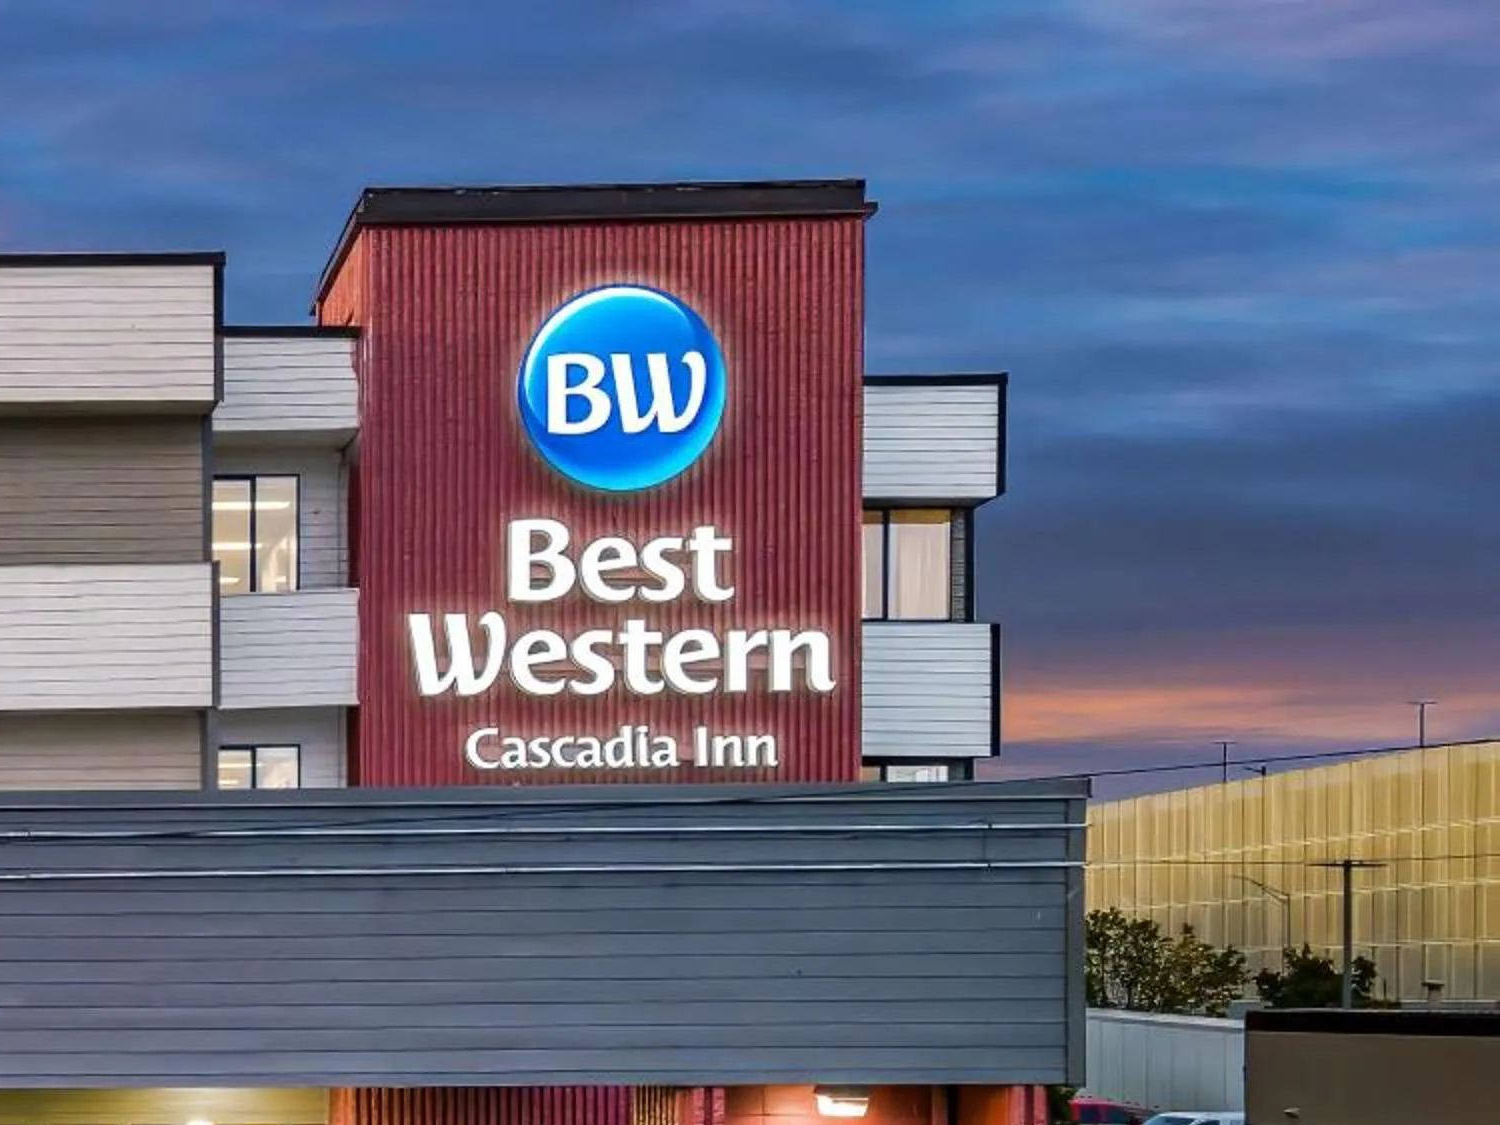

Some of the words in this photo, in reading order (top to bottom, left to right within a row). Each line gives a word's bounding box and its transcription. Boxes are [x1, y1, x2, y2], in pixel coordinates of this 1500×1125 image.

[546, 350, 706, 435] BW
[507, 518, 736, 603] Best
[407, 610, 837, 697] Western
[465, 724, 680, 770] Cascadia
[694, 725, 780, 768] Inn
